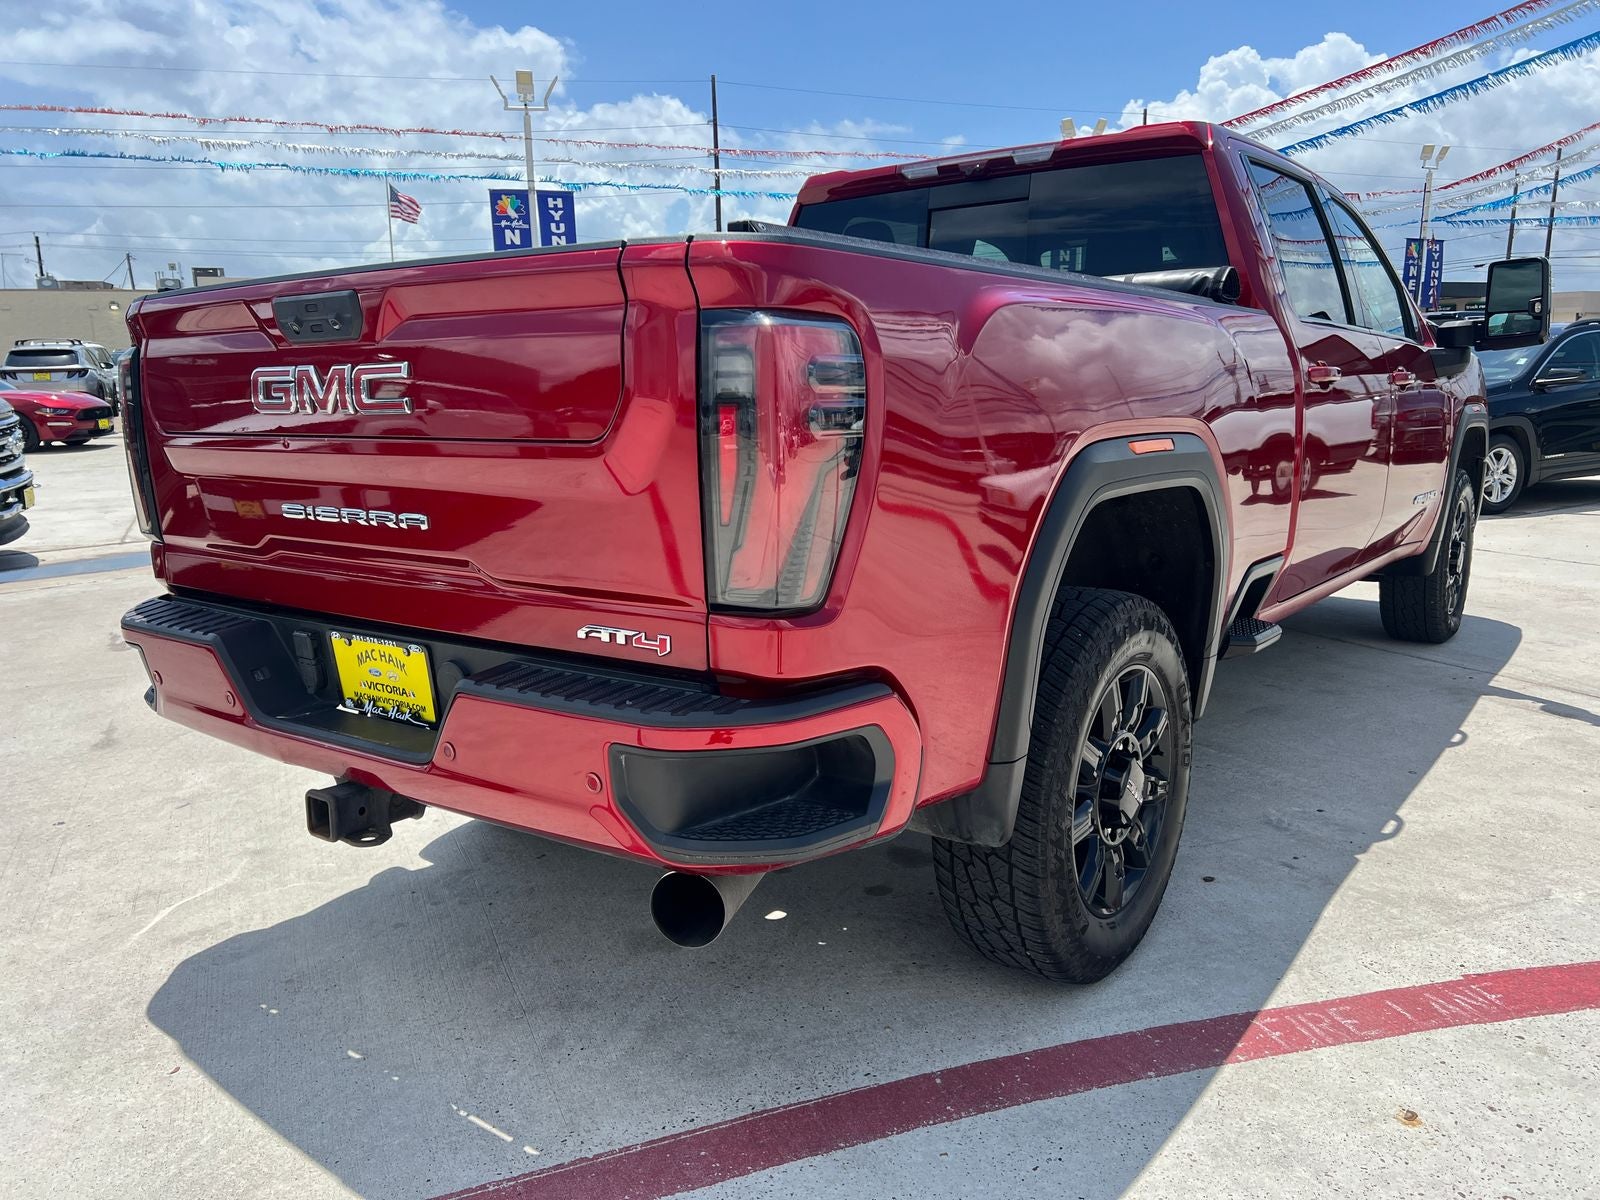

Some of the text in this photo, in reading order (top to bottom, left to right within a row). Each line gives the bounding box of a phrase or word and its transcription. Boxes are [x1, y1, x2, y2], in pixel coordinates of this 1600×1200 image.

[251, 361, 412, 415] GMC
[281, 503, 430, 531] SIERRA
[576, 624, 671, 657] AT4
[357, 648, 408, 676] MAC HAIK
[366, 680, 408, 698] VICTORIA
[363, 700, 386, 715] Mac
